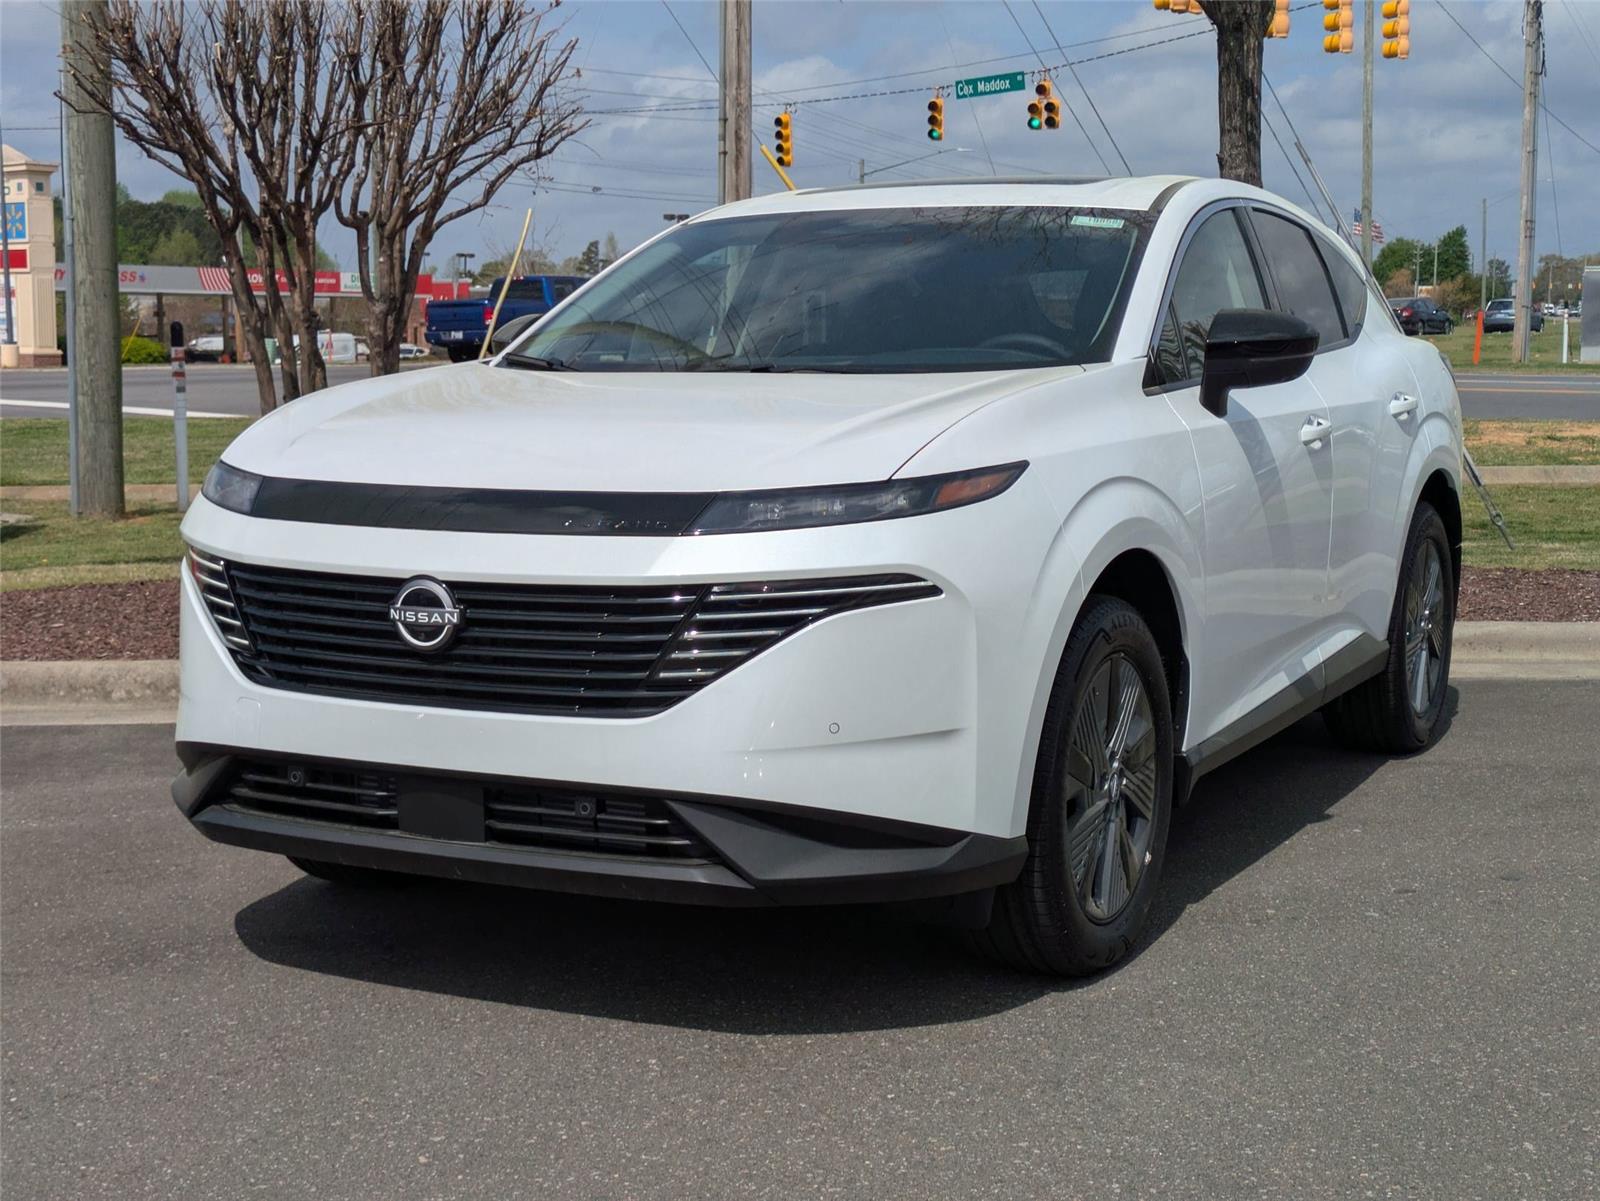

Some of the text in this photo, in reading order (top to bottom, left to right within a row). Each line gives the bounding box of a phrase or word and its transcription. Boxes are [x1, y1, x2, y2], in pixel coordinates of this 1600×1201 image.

[957, 78, 1011, 96] Cox Maddox
[389, 608, 458, 624] NISSAN
